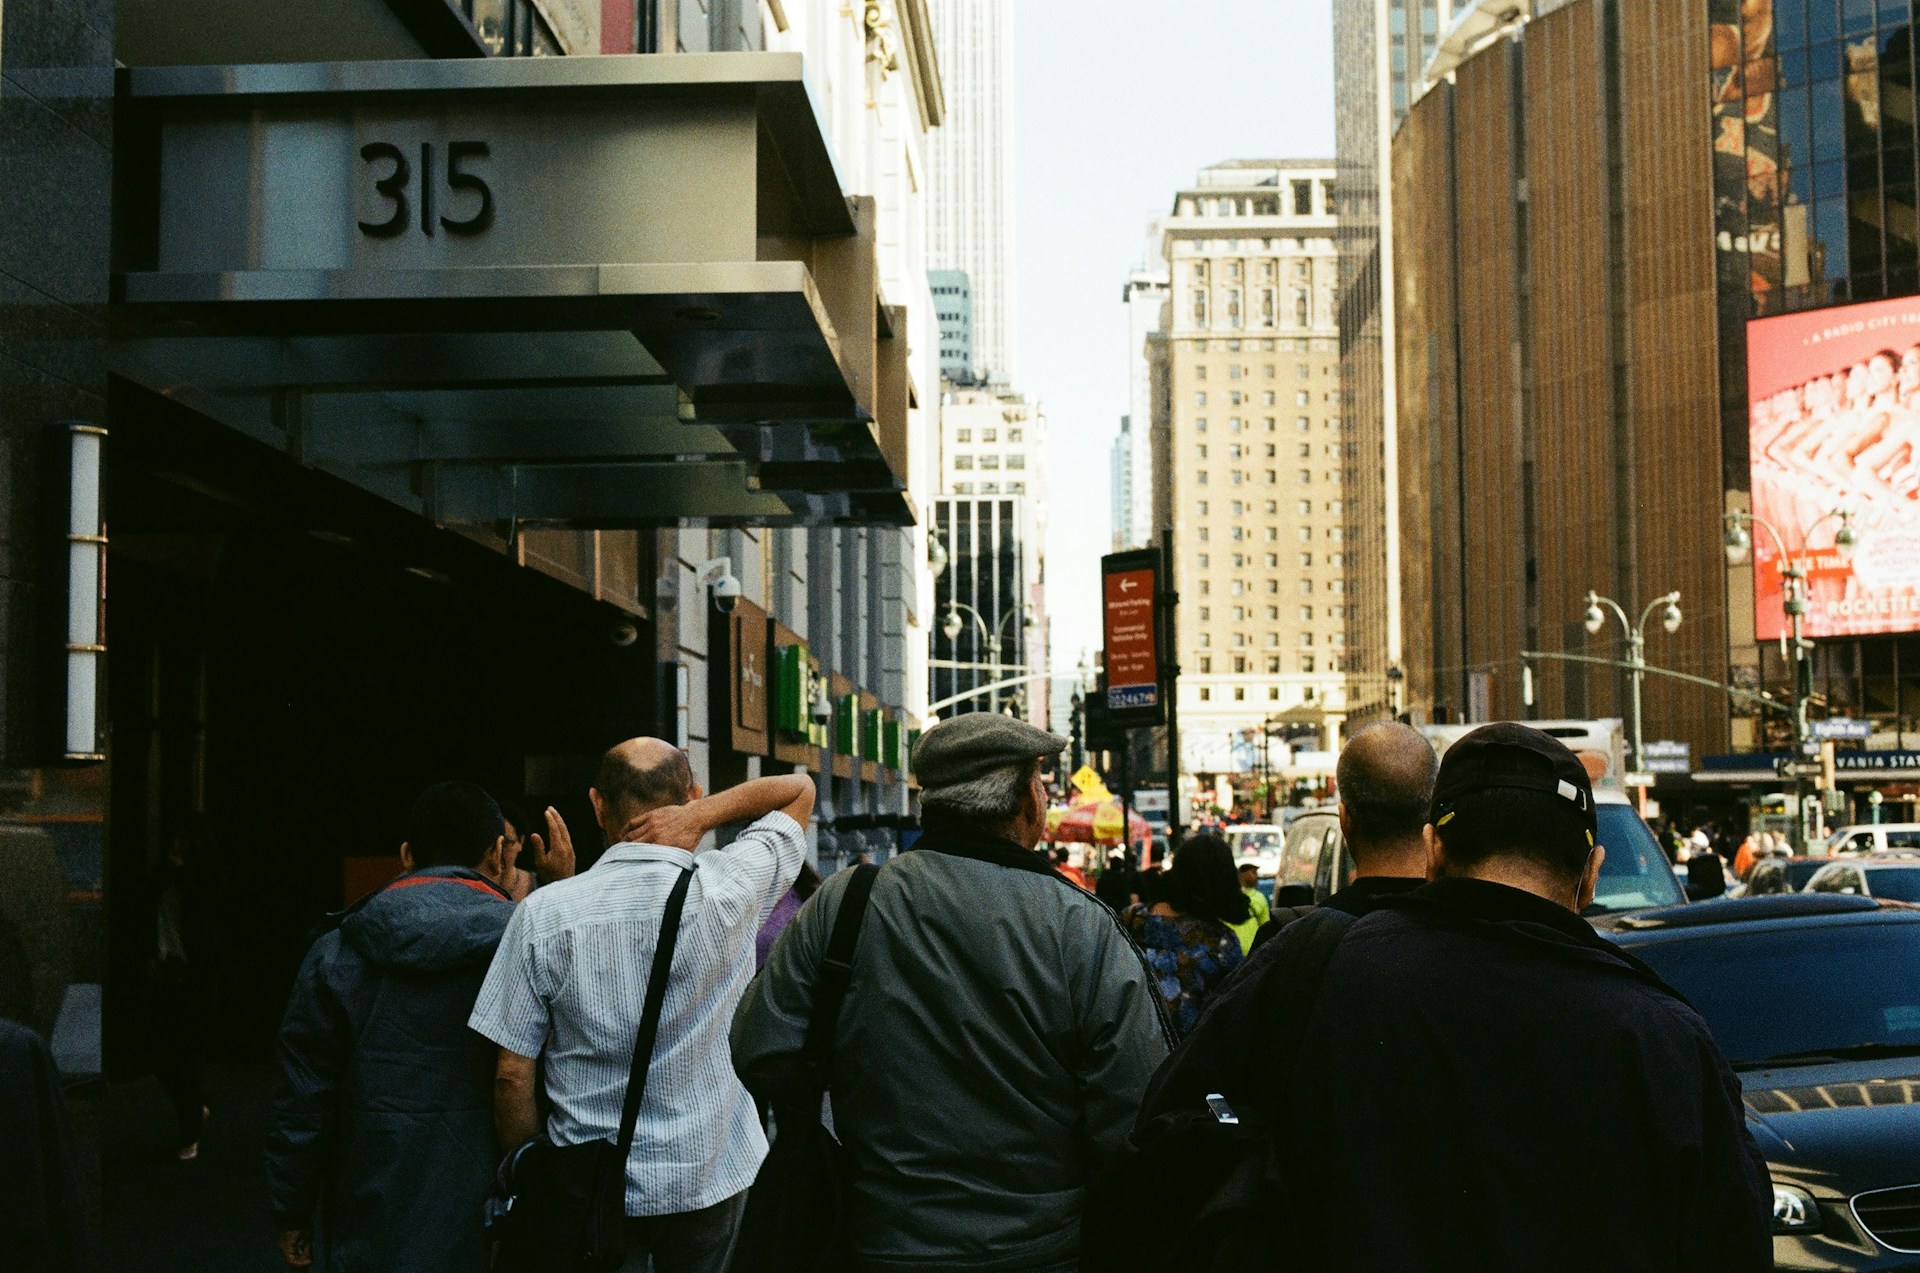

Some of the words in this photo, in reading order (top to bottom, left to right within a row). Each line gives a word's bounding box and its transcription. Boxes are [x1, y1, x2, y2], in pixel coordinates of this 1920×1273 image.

[357, 141, 495, 238] 315
[1823, 320, 1865, 340] RADIO
[1867, 315, 1897, 330] CITY
[1836, 755, 1885, 769] VANIA
